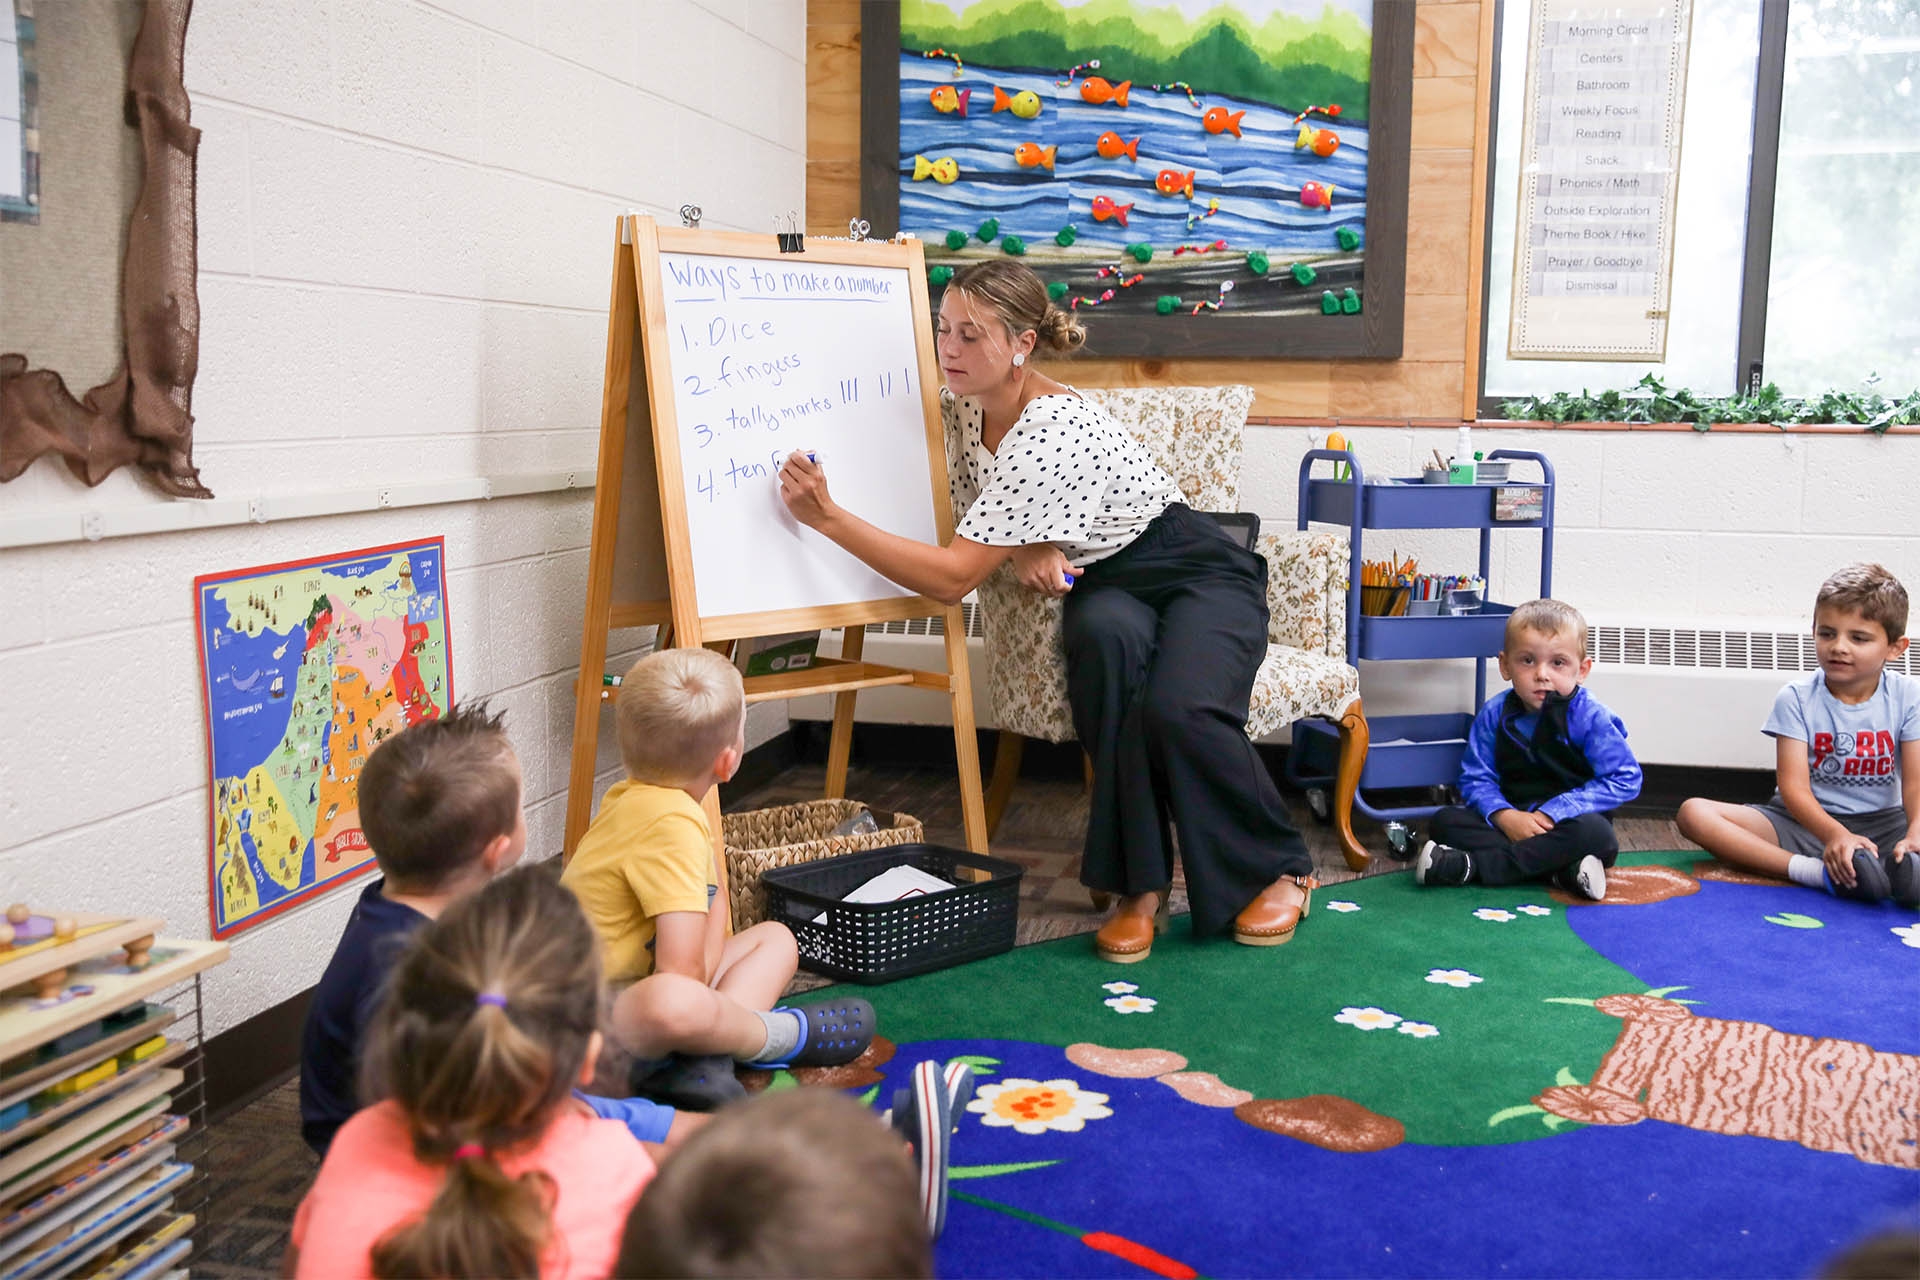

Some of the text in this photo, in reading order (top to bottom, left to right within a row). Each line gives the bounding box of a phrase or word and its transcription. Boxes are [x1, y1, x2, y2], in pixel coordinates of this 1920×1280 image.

[1568, 26, 1613, 38] Morning
[1580, 53, 1624, 64] Centers
[1576, 80, 1631, 91] Bathroom
[1561, 104, 1639, 117] Weekly Focus
[1576, 128, 1622, 140] Reading
[1585, 155, 1619, 166] Snack
[1559, 178, 1603, 188] Phonics
[1612, 178, 1641, 188] Math
[1544, 205, 1650, 217] Outside Exploration
[1544, 228, 1581, 239] Theme
[1583, 228, 1612, 239] Book
[1621, 228, 1647, 239] Hike
[1548, 256, 1584, 268] Prayer
[1593, 256, 1643, 268] Goodbye
[669, 260, 741, 301] Ways
[750, 267, 775, 292] to
[783, 272, 829, 294] make
[1565, 280, 1618, 291] Dismissal
[680, 316, 775, 352] 1. Dice
[684, 354, 801, 396] 2. fingers
[694, 423, 721, 449] 3.
[697, 469, 721, 503] 4.
[725, 457, 767, 489] ten
